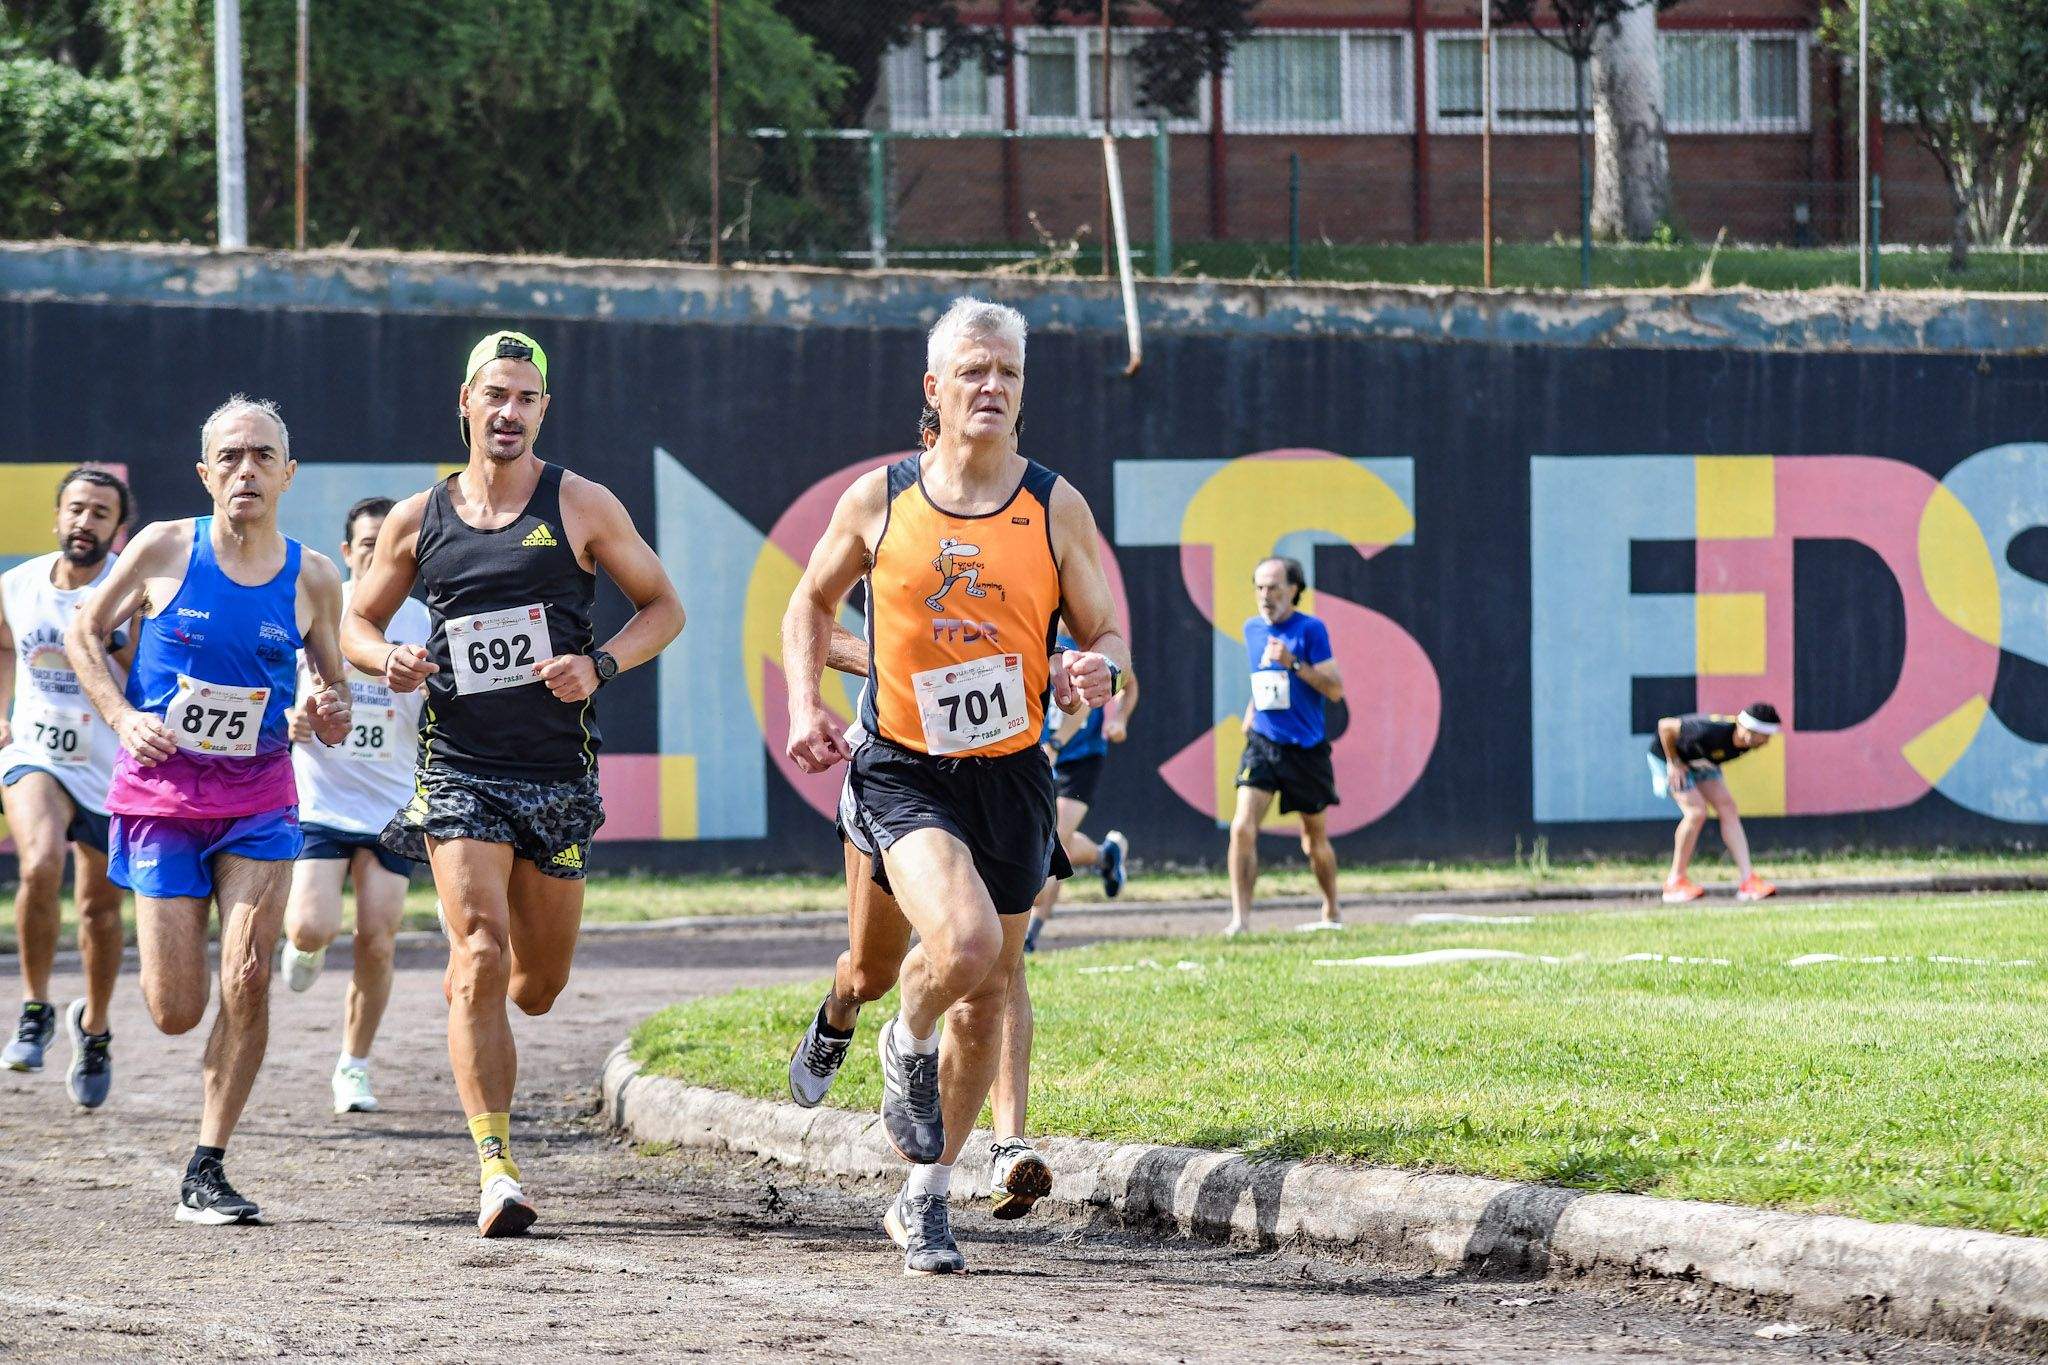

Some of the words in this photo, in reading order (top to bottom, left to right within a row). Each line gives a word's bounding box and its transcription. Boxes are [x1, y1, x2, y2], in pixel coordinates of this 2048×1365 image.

[522, 538, 557, 547] adidas
[468, 634, 536, 674] 692
[503, 673, 524, 683] rasán
[938, 682, 1008, 732] 701
[182, 704, 248, 740] 875
[1007, 717, 1025, 730] 2023
[35, 722, 77, 752] 730
[341, 725, 384, 748] 38
[982, 727, 1001, 740] rasán
[234, 744, 252, 752] 2023
